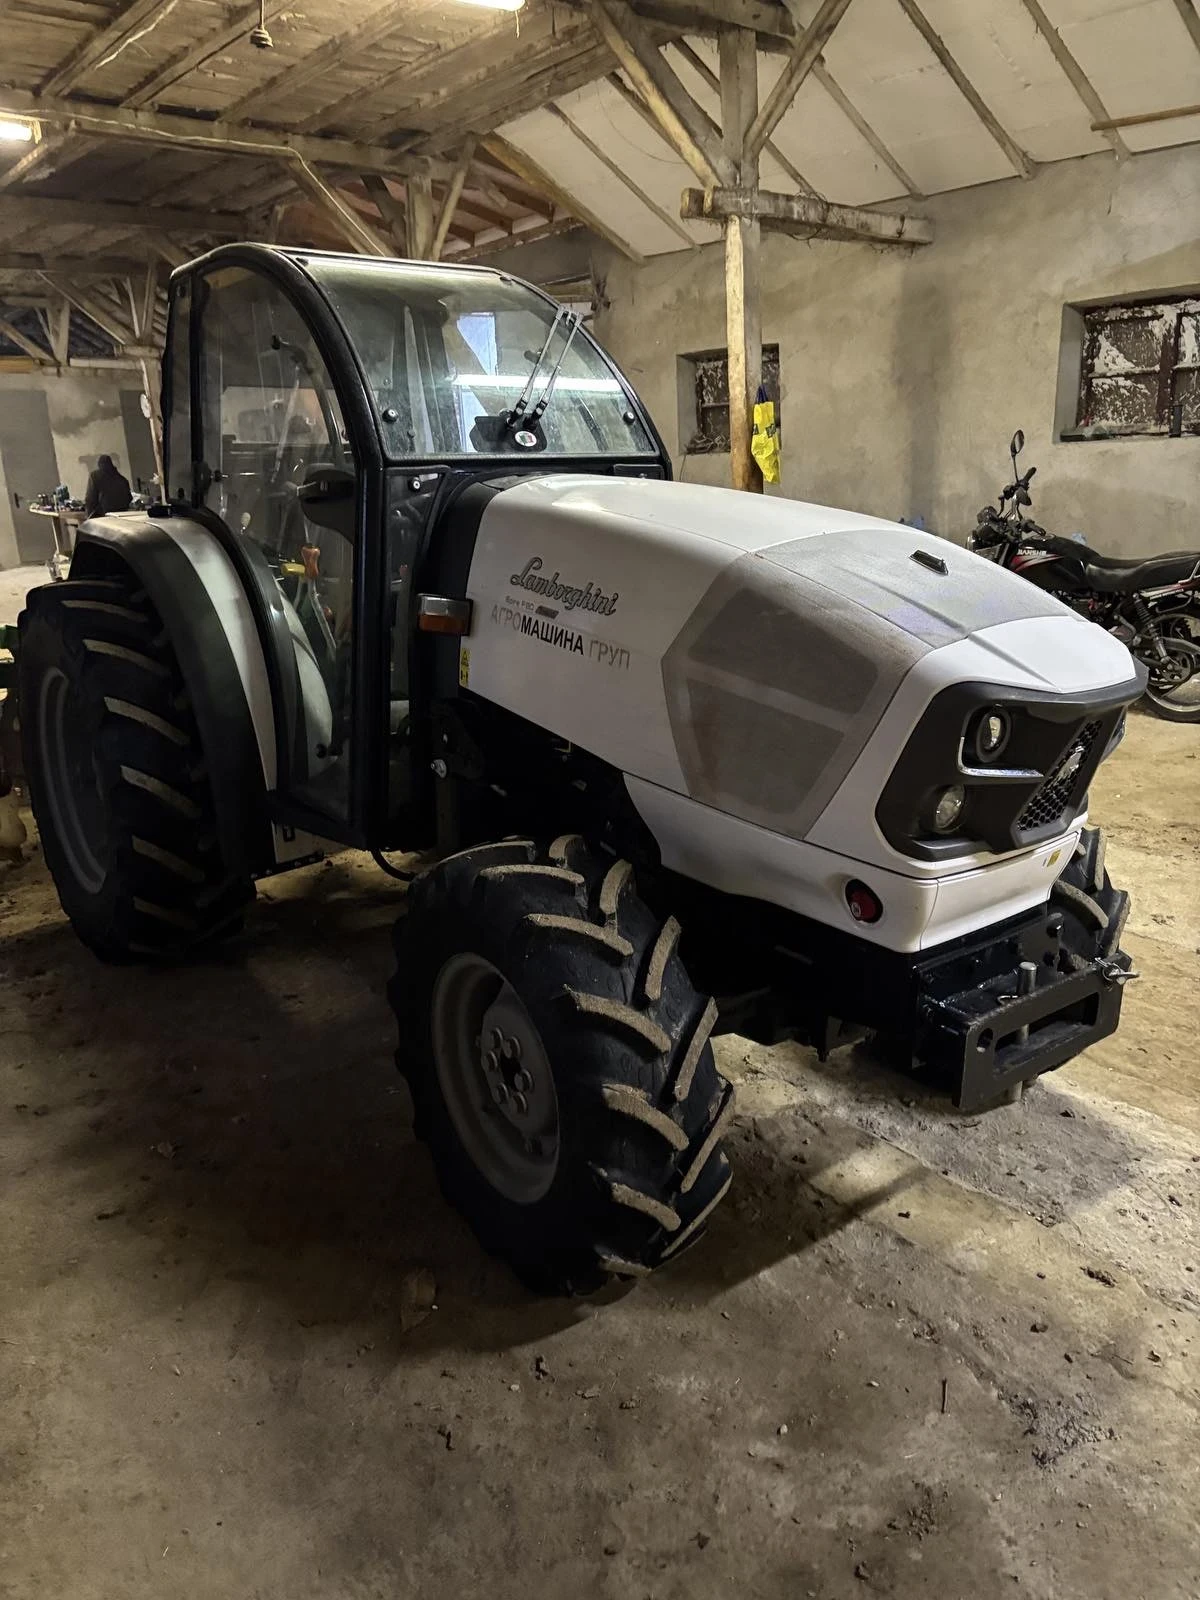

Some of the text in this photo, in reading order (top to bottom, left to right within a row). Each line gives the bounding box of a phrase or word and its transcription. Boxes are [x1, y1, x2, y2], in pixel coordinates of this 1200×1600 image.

[510, 556, 619, 616] Lamborghini
[490, 604, 631, 669] АГРОМАШИНА ГРУП
